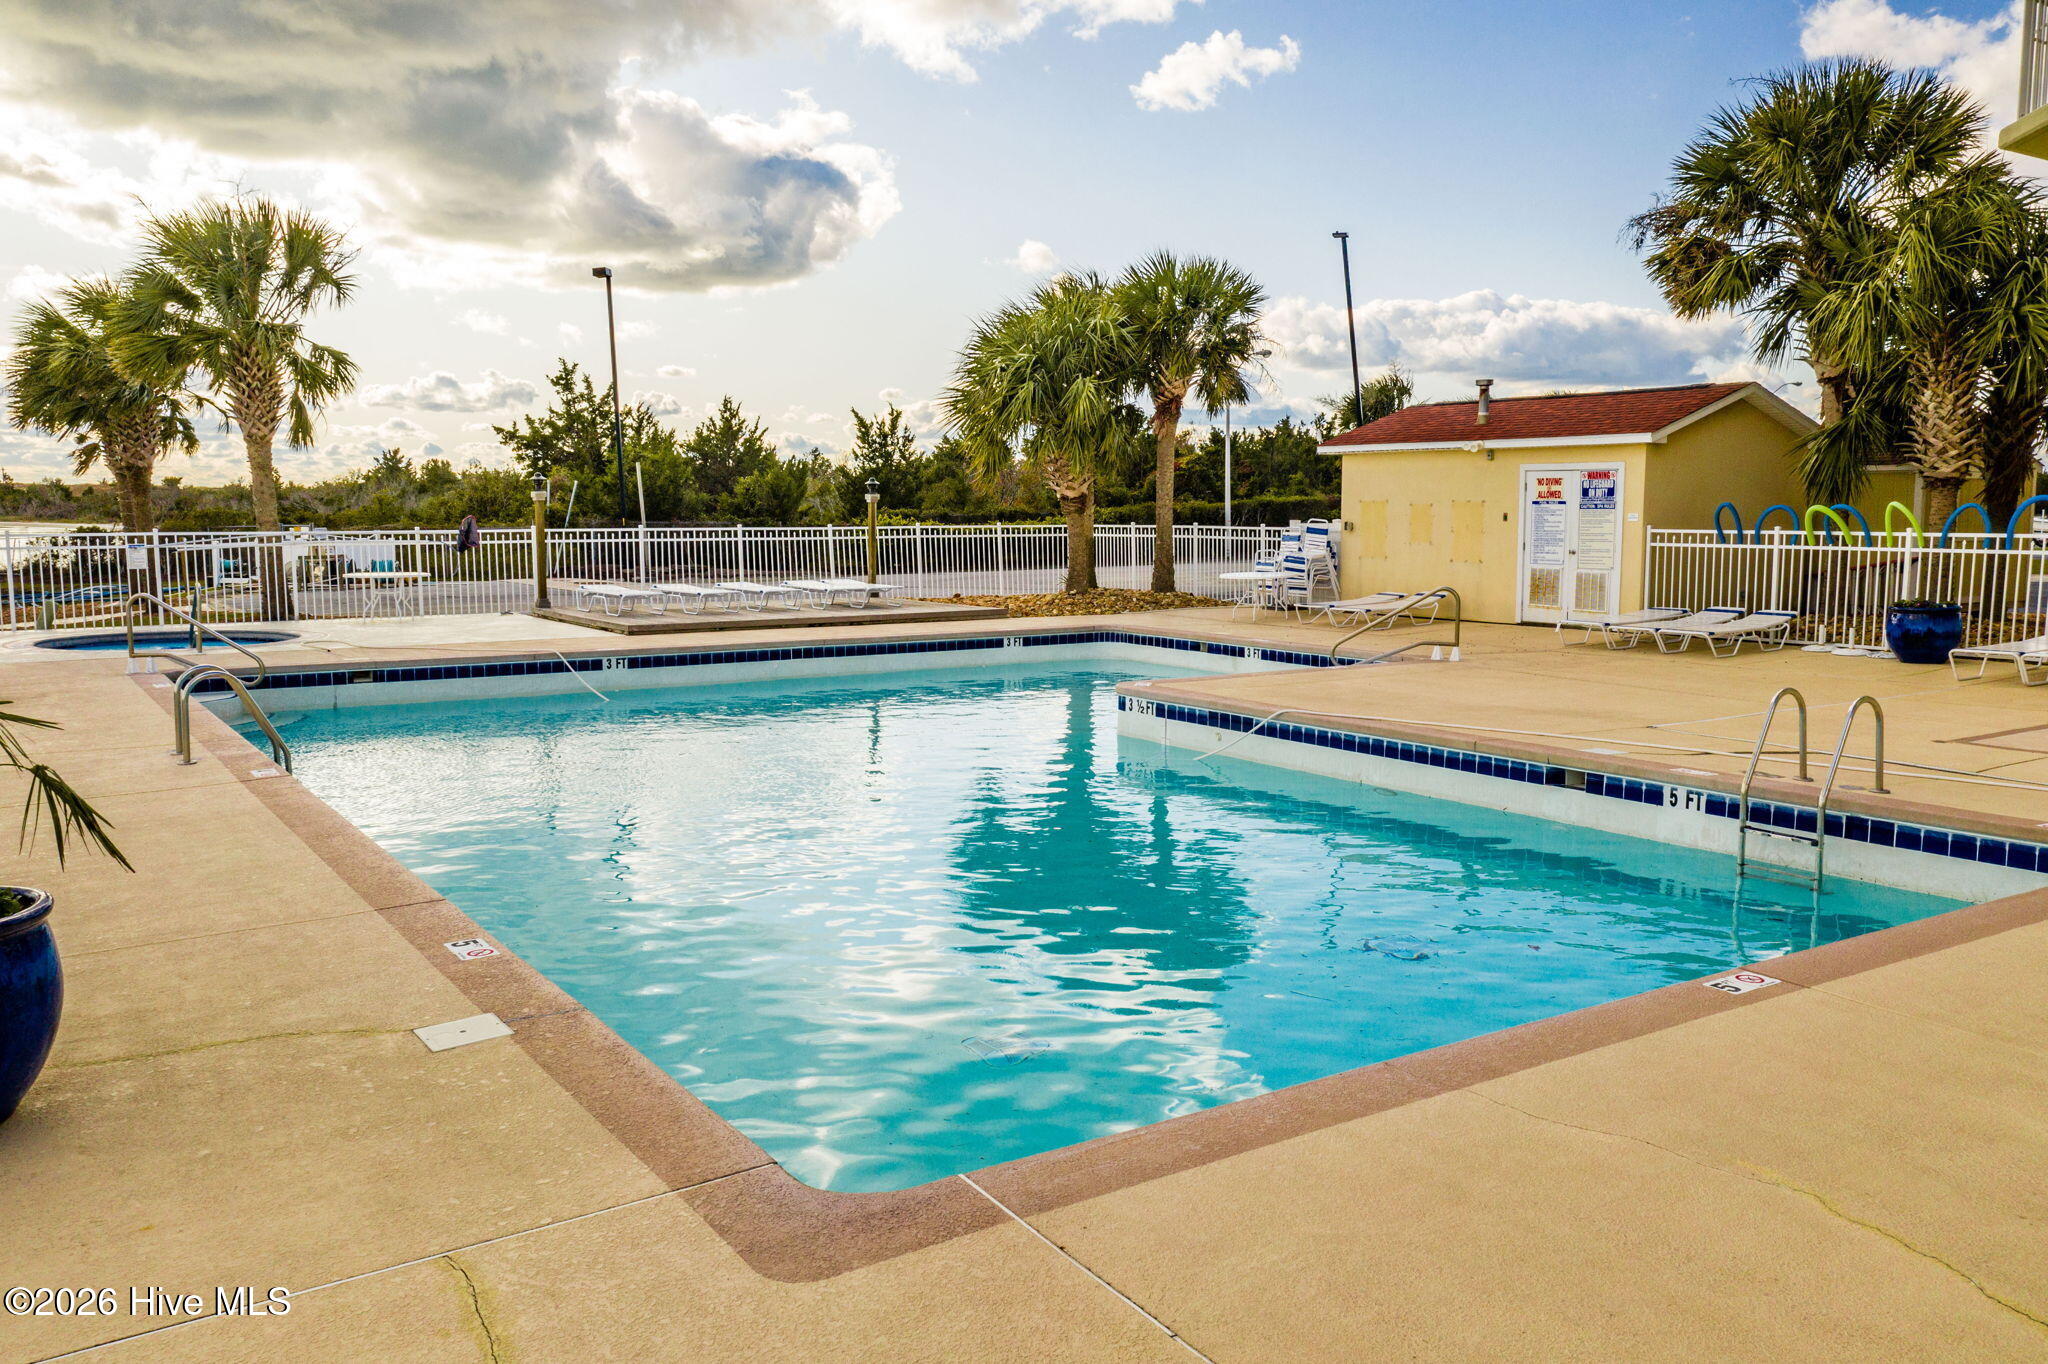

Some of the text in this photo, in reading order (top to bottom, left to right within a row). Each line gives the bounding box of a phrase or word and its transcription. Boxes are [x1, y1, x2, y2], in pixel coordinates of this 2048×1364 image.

[1588, 471, 1610, 480] WARNING
[1537, 478, 1562, 486] NO DIVING
[1006, 637, 1022, 647] 3 FT
[1246, 647, 1260, 659] 3 FT
[606, 657, 627, 670] 3 FT
[1128, 698, 1134, 712] 3
[1146, 701, 1156, 715] FT
[1669, 786, 1704, 811] 5 FT
